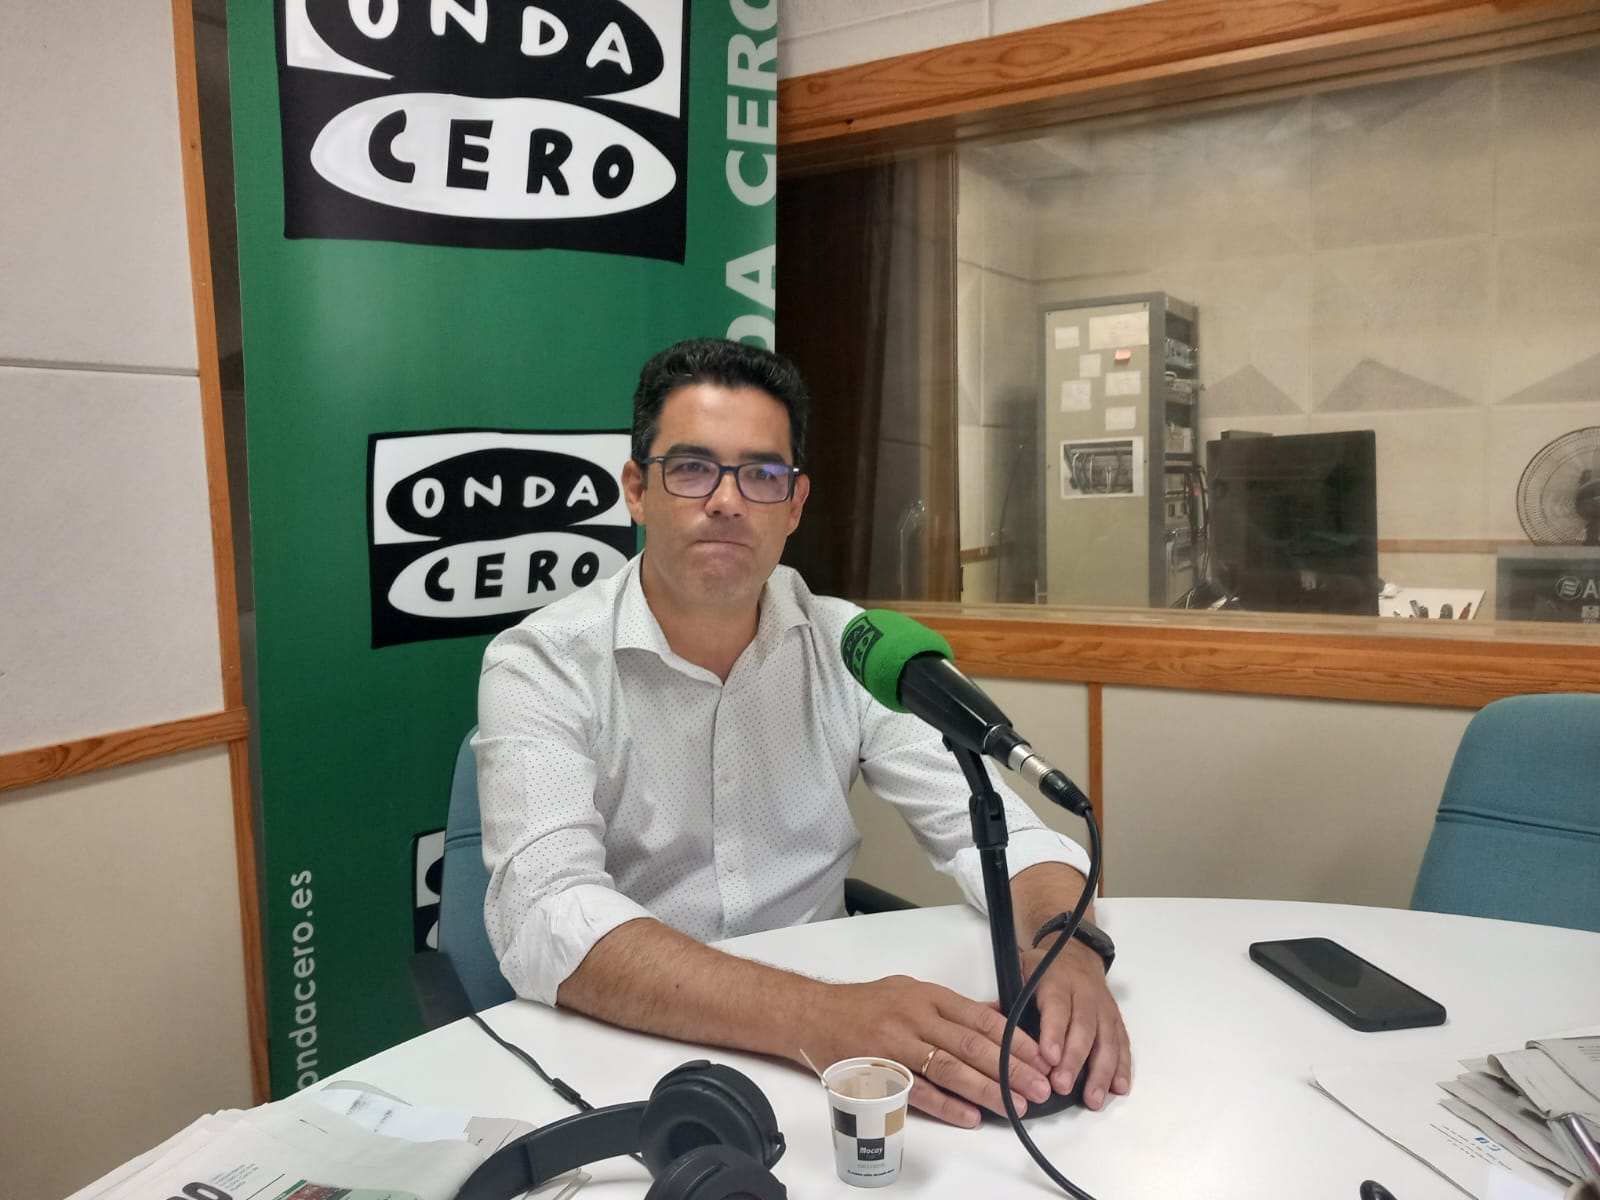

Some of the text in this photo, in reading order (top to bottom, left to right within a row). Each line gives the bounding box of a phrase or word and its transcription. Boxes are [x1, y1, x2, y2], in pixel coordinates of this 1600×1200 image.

[348, 0, 633, 75] ONDA
[368, 109, 635, 199] CERO
[411, 474, 599, 519] ONDA
[424, 550, 600, 602] CERO
[288, 870, 319, 1090] ondacero.es
